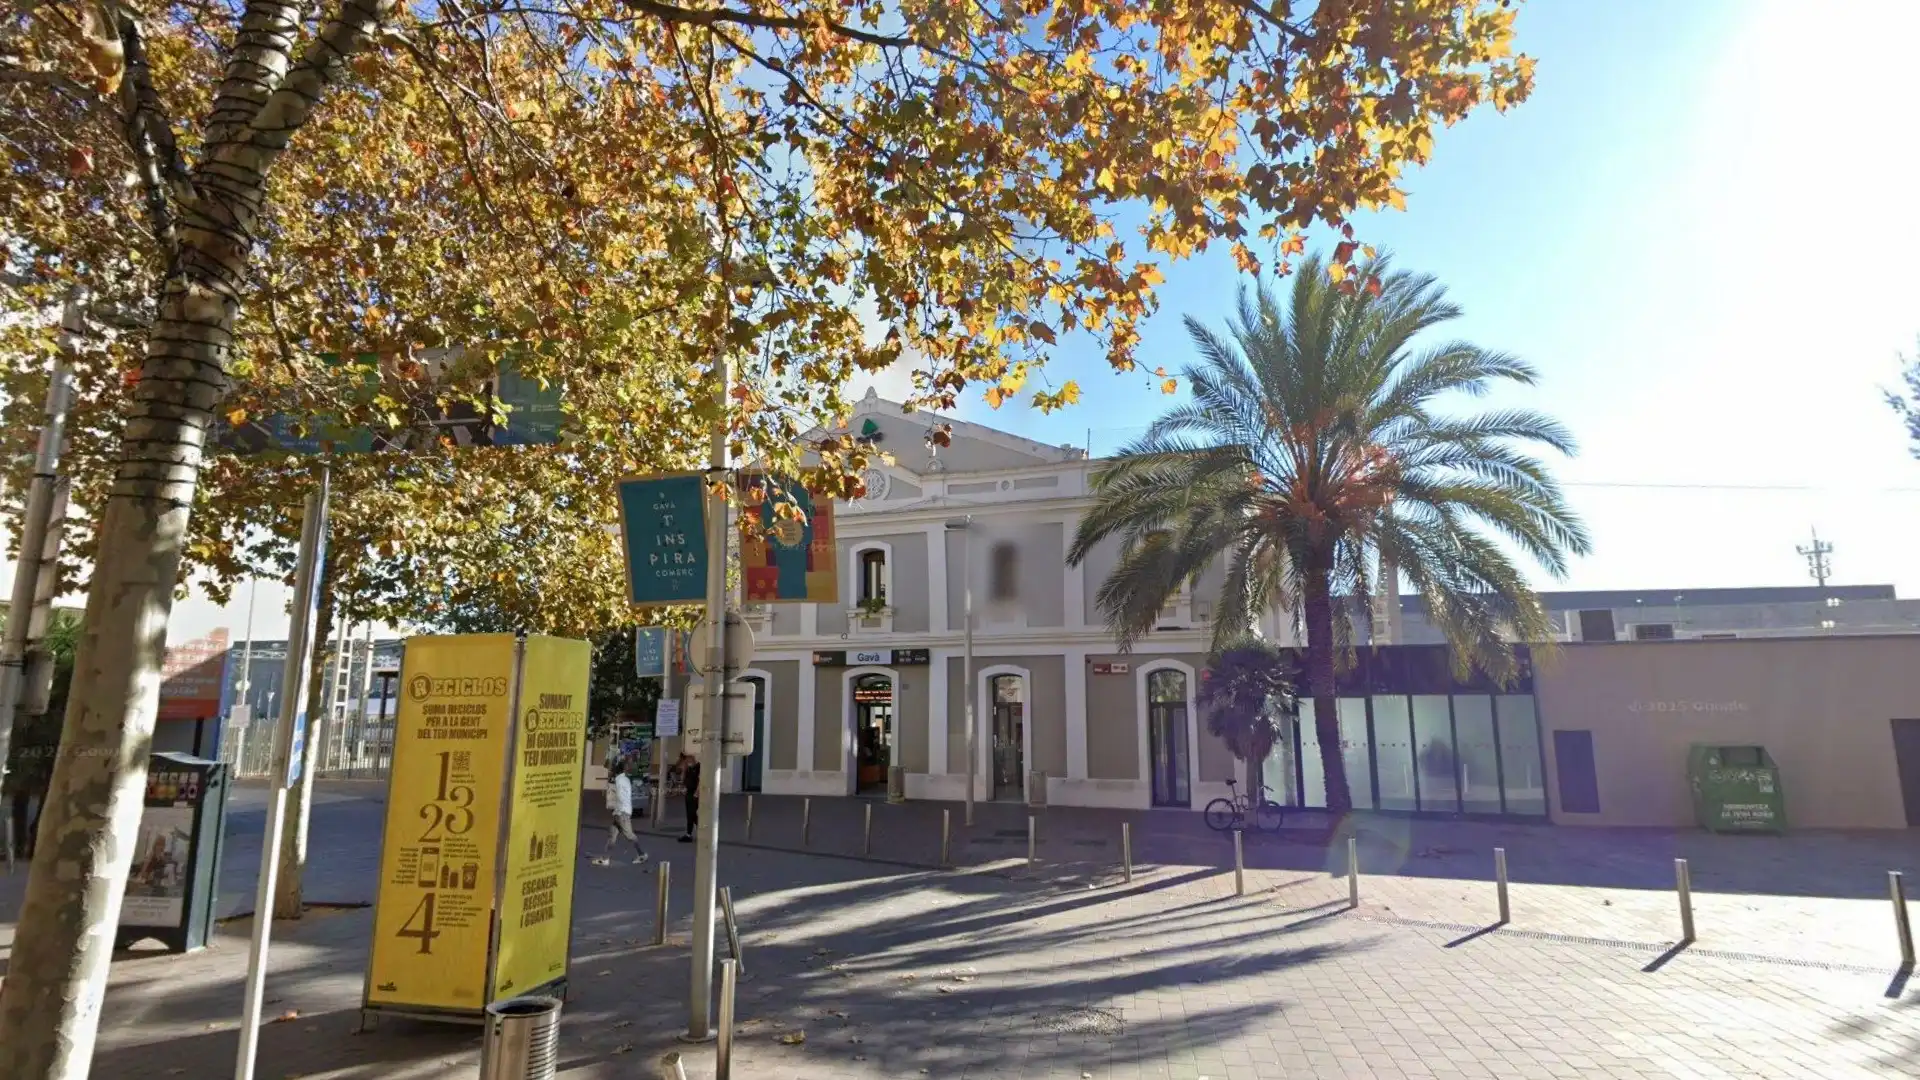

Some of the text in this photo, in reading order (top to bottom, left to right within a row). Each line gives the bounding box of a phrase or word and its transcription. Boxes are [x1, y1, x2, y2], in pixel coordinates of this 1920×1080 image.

[656, 533, 685, 546] INS
[649, 552, 696, 566] PIRA
[857, 652, 880, 662] Gavà
[407, 673, 507, 702] RECICLOS
[421, 703, 487, 715] SUMA RECICLOS
[540, 693, 573, 709] SUMANT
[425, 716, 481, 727] PER A LA GENT
[525, 708, 584, 732] RECICLOS
[417, 728, 488, 739] DEL TEU MUNICIPI
[526, 731, 577, 749] HI GUANYA EL
[524, 748, 578, 767] TEU MUNICIPI
[434, 752, 450, 801] 1
[445, 785, 474, 835] 3
[418, 803, 443, 843] 2
[395, 892, 441, 954] 4
